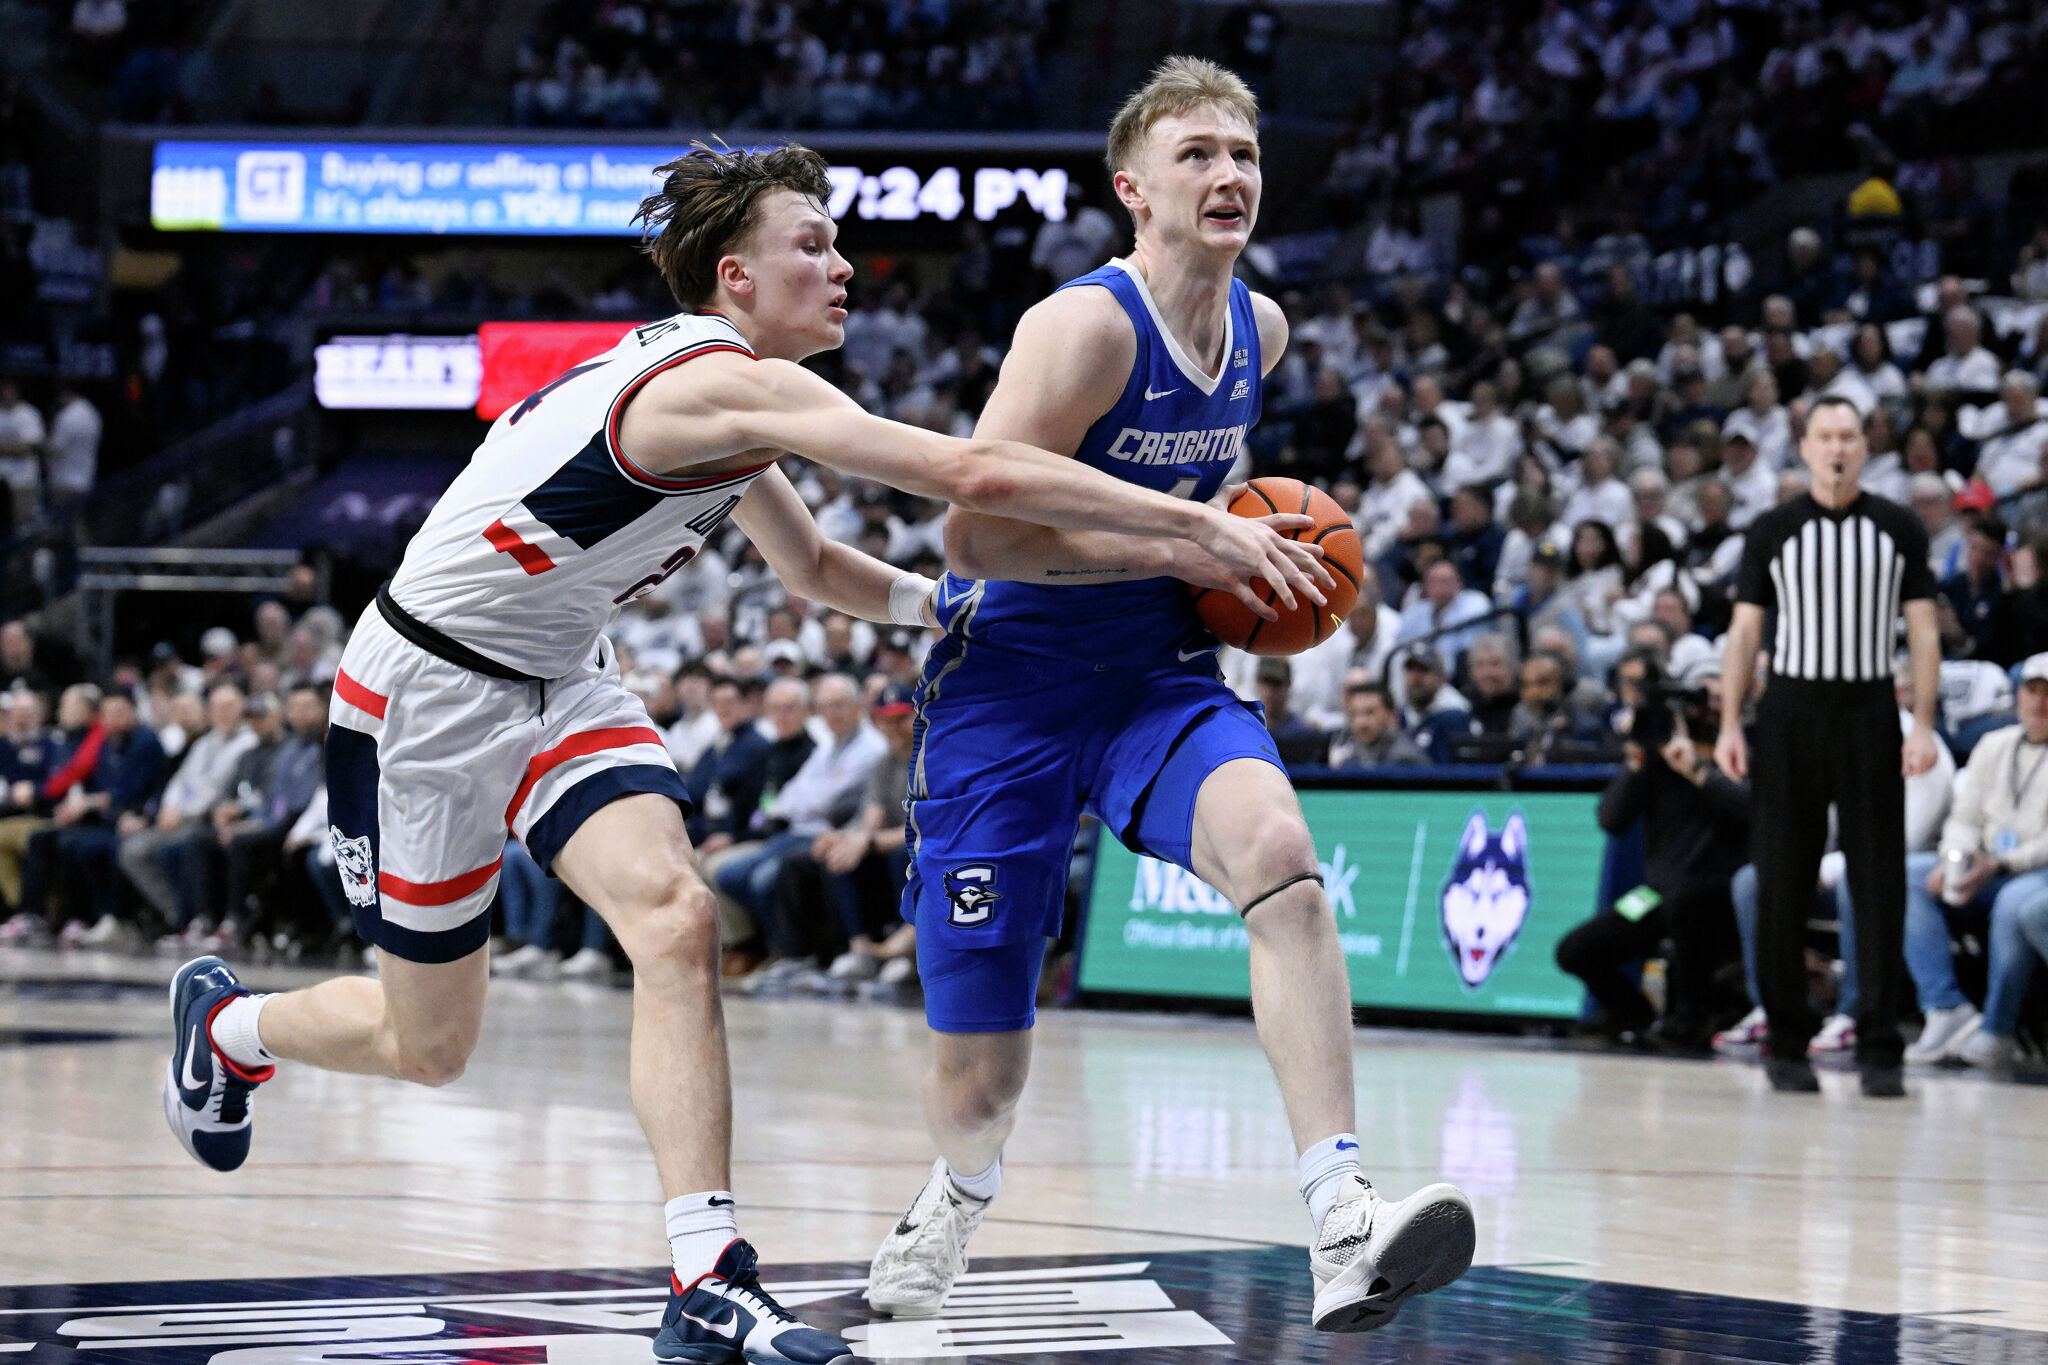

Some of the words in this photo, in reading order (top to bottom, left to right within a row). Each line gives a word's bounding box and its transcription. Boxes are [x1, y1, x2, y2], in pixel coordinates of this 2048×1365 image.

[321, 151, 424, 196] Buying
[425, 161, 463, 189] or
[466, 152, 561, 194] selling
[590, 152, 668, 190] hom
[820, 166, 964, 221] 7:24
[973, 167, 1068, 222] PM
[363, 188, 468, 234] always
[502, 190, 582, 228] YOU
[1231, 386, 1250, 398] EAST
[1235, 379, 1248, 390] BIG
[1106, 423, 1247, 466] CREIGHTON
